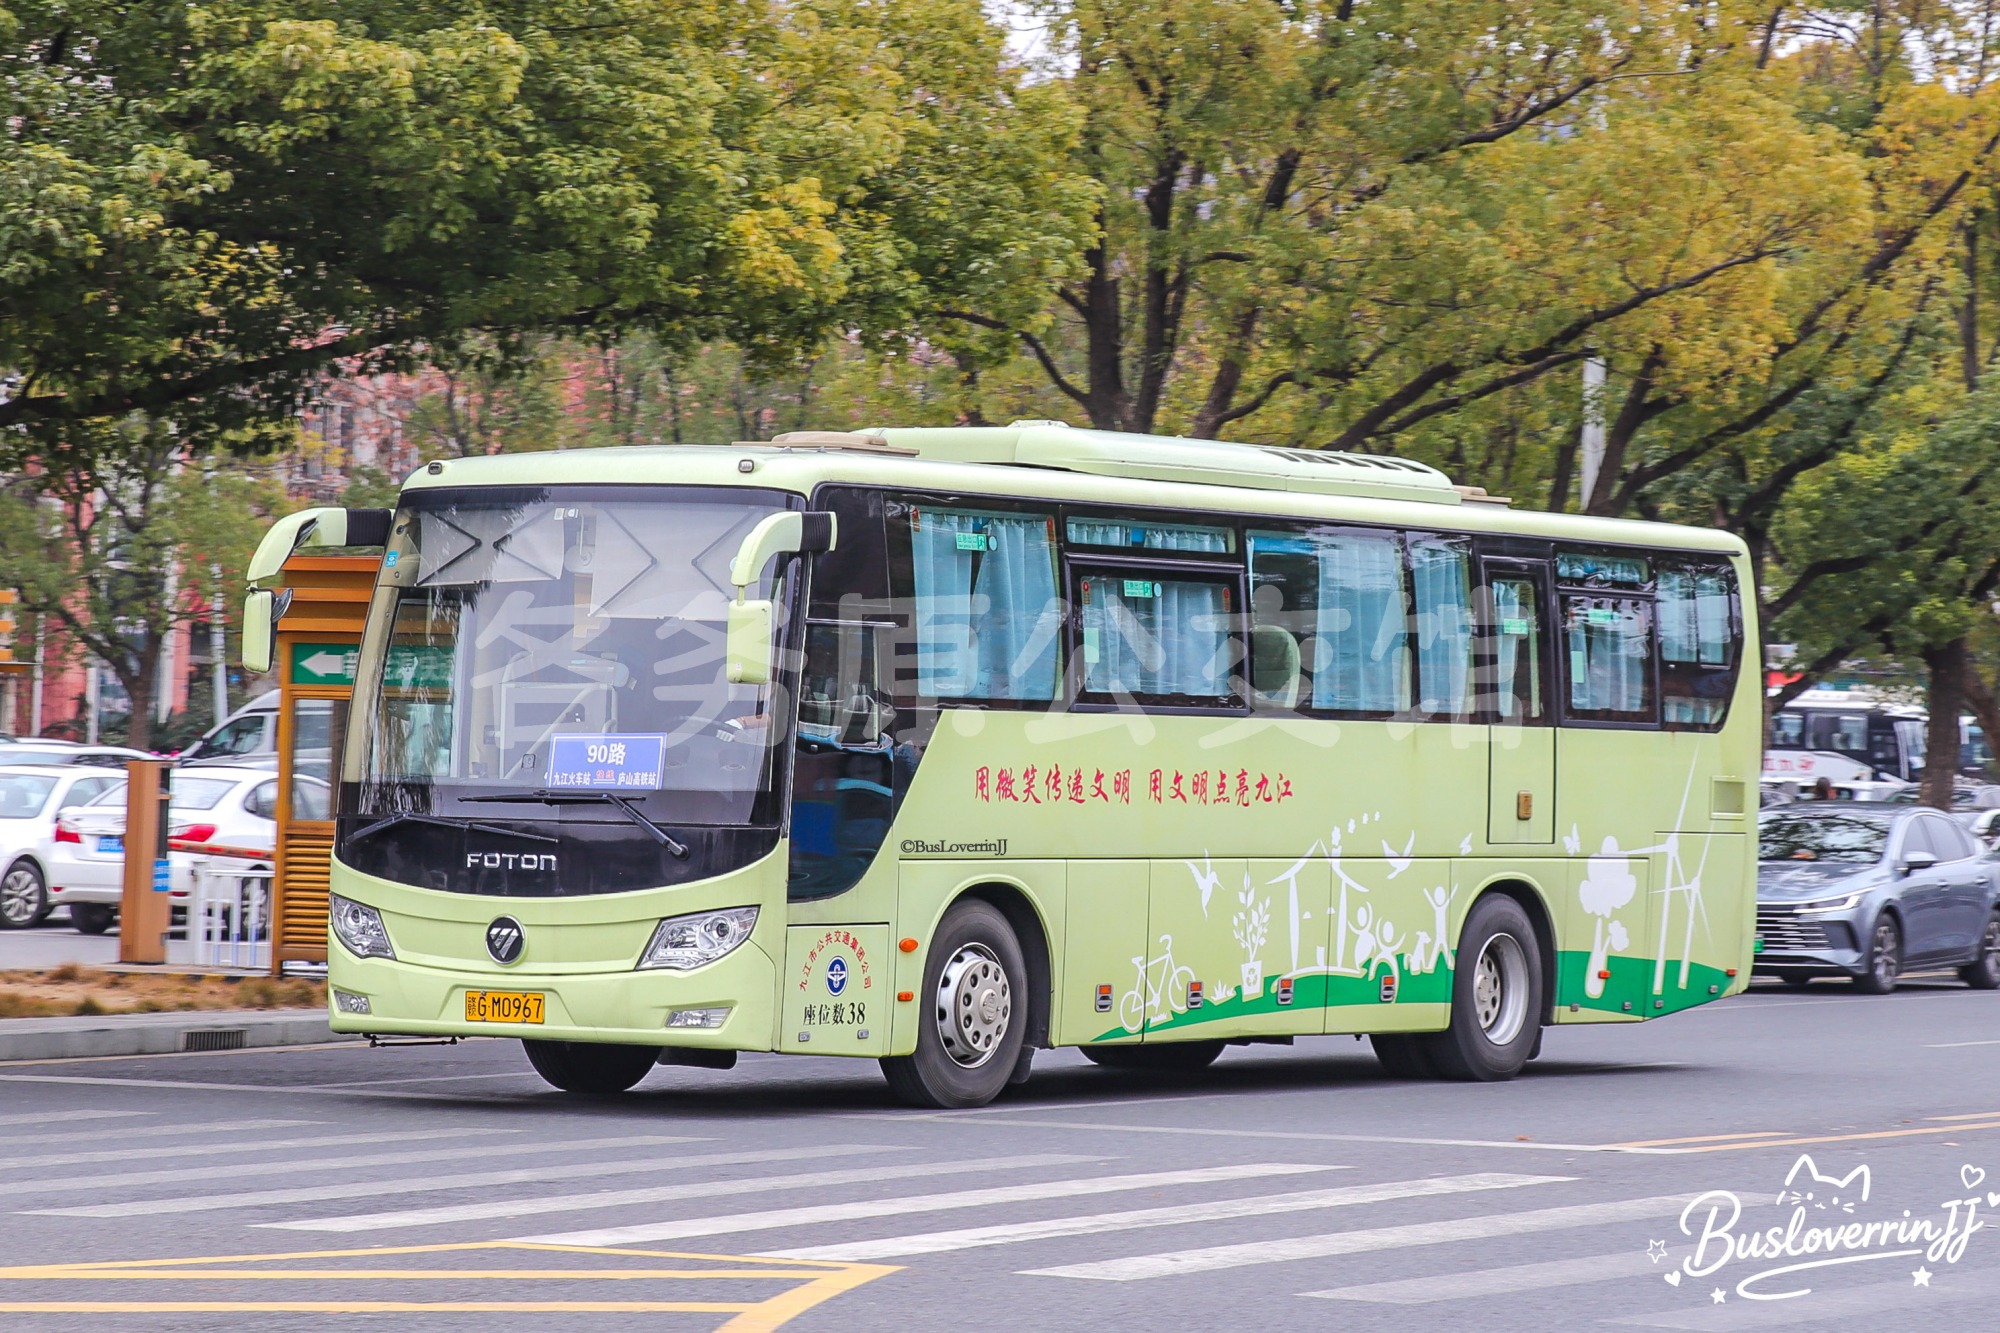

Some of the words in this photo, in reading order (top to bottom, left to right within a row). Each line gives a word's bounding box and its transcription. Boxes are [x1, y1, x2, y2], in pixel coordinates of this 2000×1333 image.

[587, 742, 626, 765] 90路
[553, 772, 591, 786] 九江火车站
[617, 772, 656, 786] 庐山高铁站
[975, 763, 1131, 804] 用微笑传递文明
[1147, 768, 1294, 807] 用文明点亮九江
[466, 852, 558, 871] FOTON
[799, 930, 872, 992] 九江市公共交通集团公司
[803, 1002, 866, 1026] 座位数38
